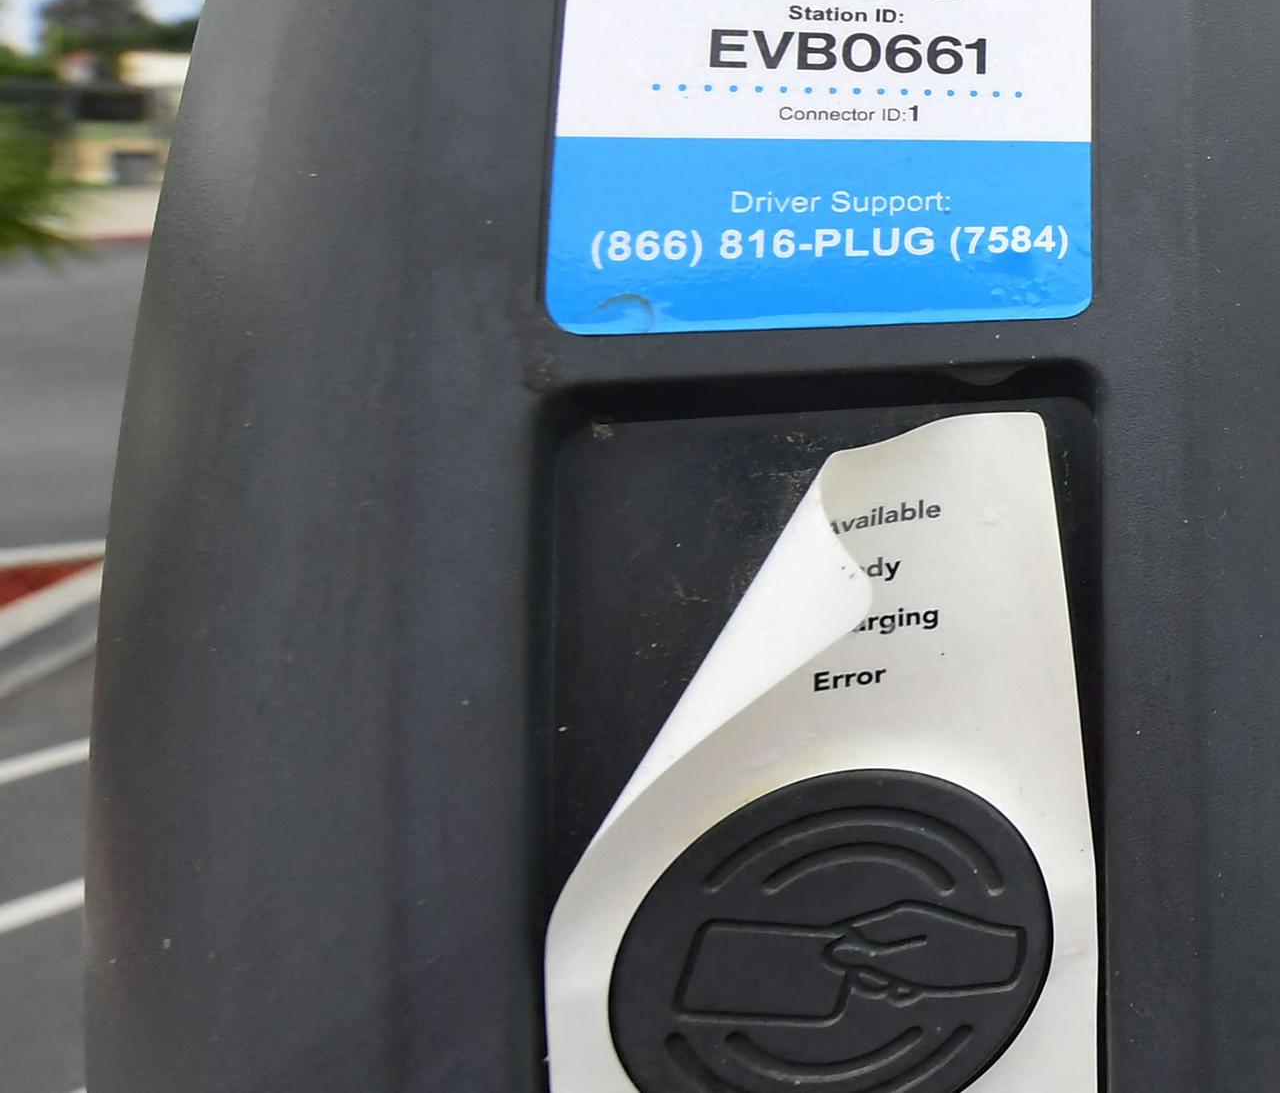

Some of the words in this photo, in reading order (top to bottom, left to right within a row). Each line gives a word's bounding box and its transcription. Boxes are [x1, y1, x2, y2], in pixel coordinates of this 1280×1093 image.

[789, 6, 868, 24] Station
[875, 9, 904, 24] ID:
[779, 106, 875, 122] Connector
[731, 191, 821, 213] Driver
[831, 191, 951, 219] Support:
[591, 229, 703, 269] (866)
[719, 227, 935, 260] 816-PLUG
[950, 225, 1069, 262] (7584)
[813, 665, 887, 692] Error
